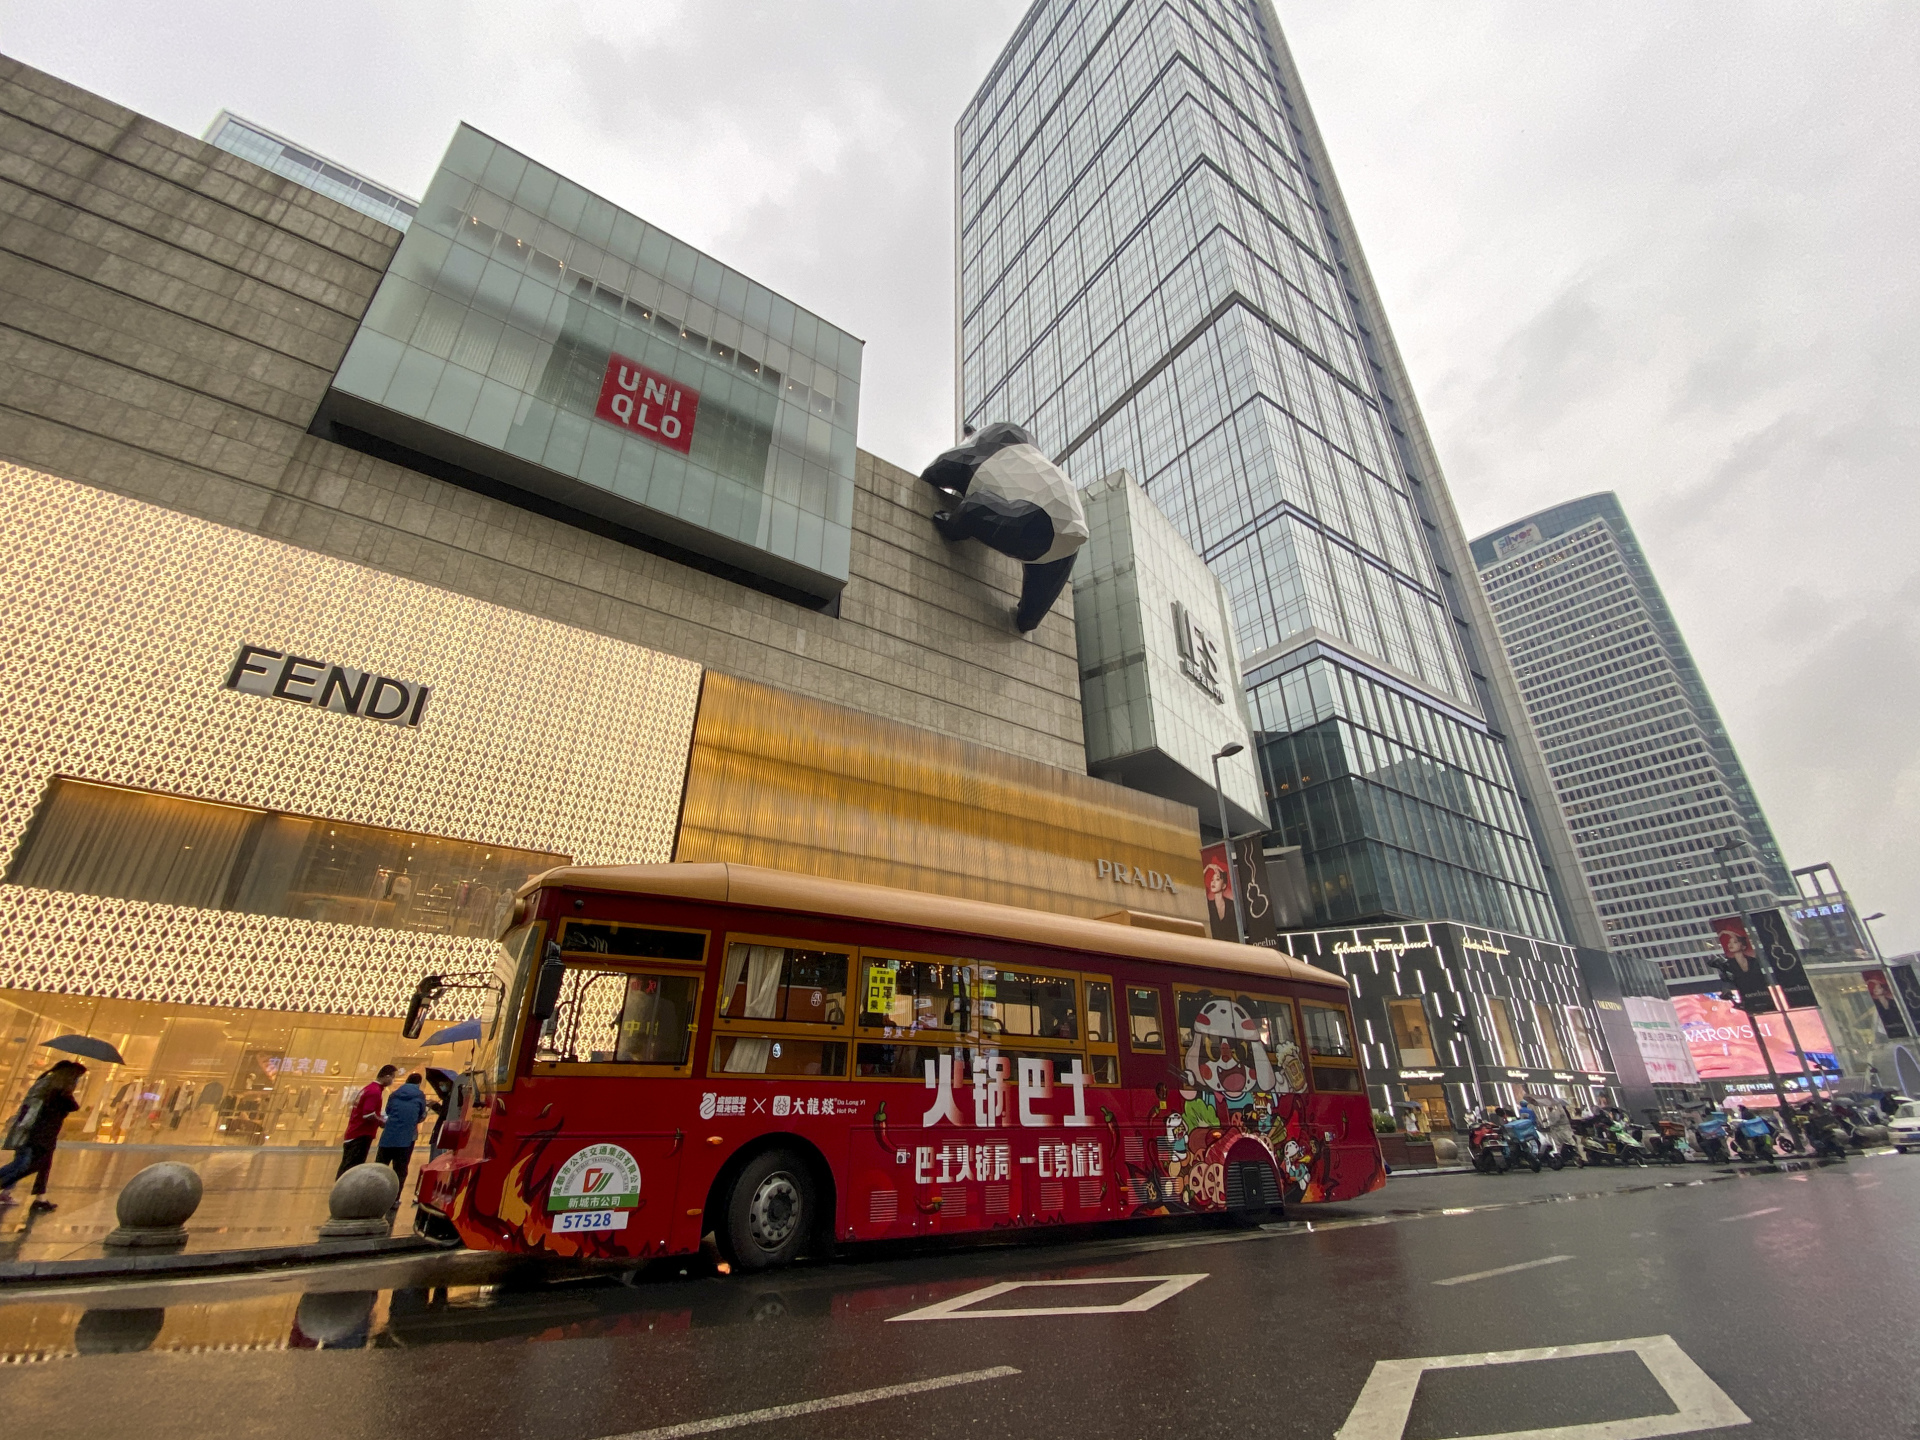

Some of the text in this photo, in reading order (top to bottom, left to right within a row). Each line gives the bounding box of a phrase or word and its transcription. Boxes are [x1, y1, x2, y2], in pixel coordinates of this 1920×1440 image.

[617, 365, 681, 412] UNI
[611, 394, 681, 439] QLO
[1170, 600, 1219, 684] IFS
[227, 645, 429, 727] FENDI
[1097, 858, 1179, 894] PRADA
[1333, 939, 1432, 957] Salvatore Ferragamo
[871, 986, 892, 999] 口罩
[1682, 1022, 1773, 1043] WAROVSI
[922, 1054, 1096, 1128] 火锅巴士
[552, 1145, 639, 1195] 成都市公共交通集团有限公司
[563, 1212, 612, 1229] 57528
[568, 1196, 621, 1208] 新城市公司
